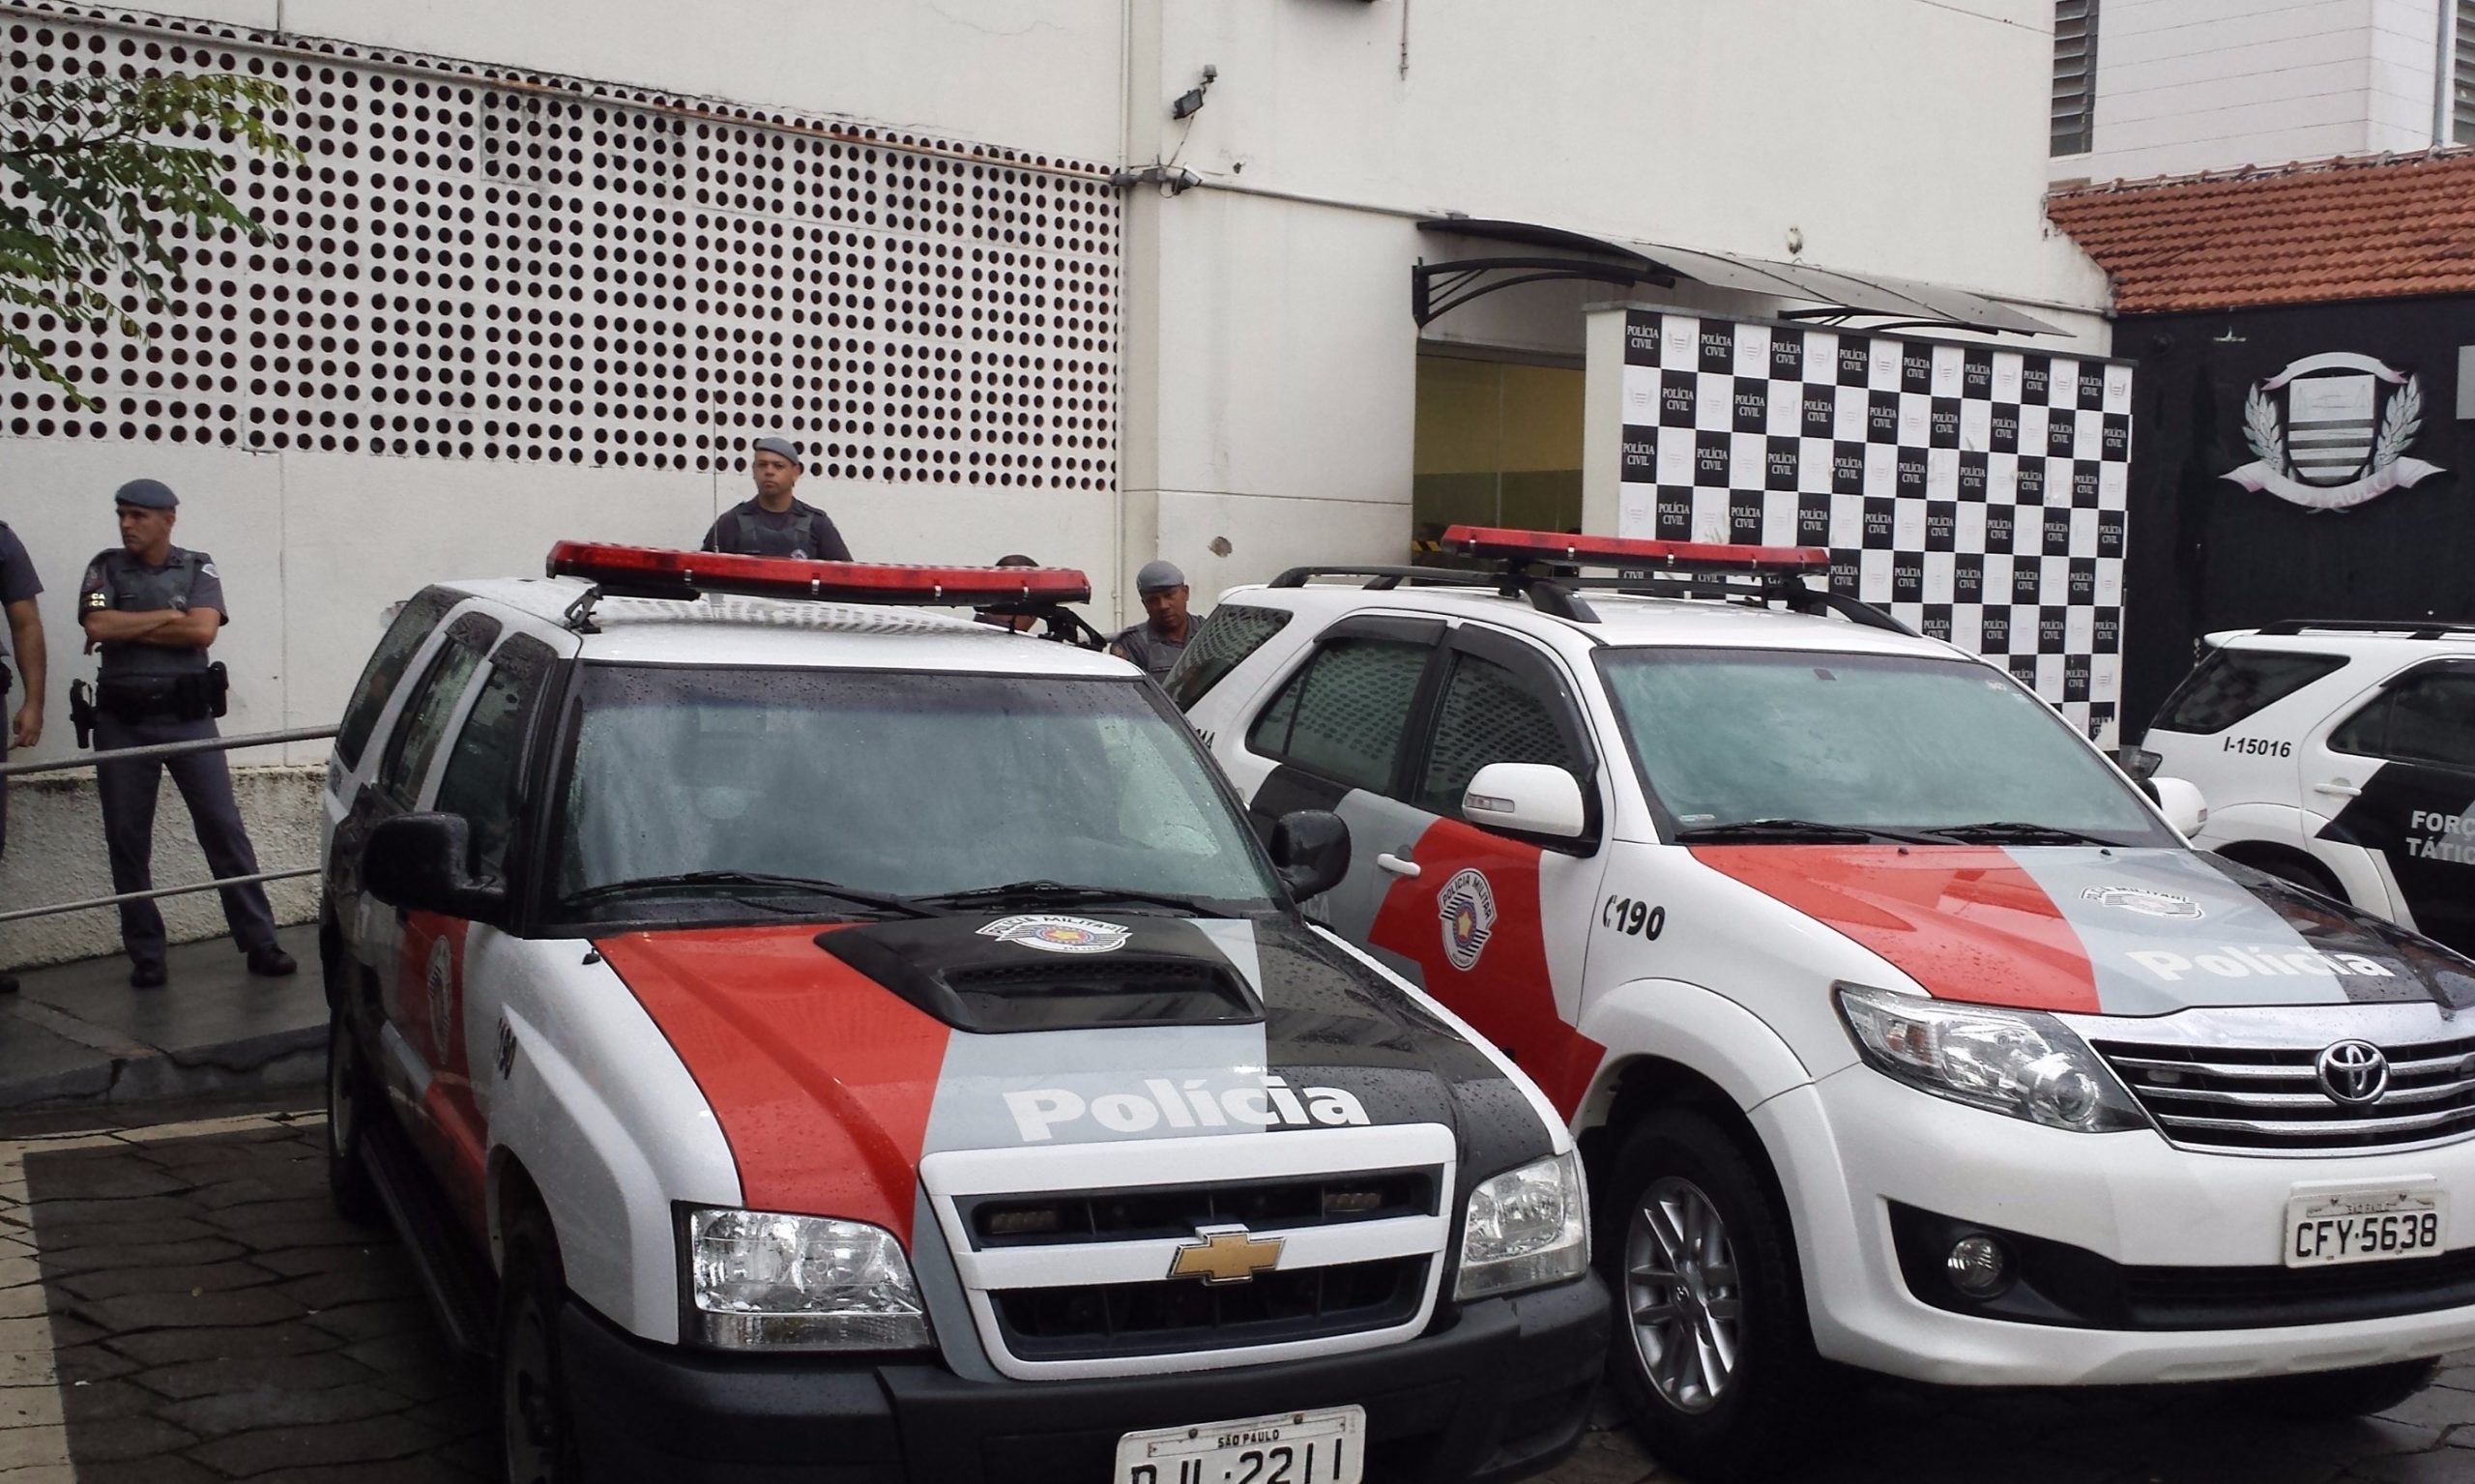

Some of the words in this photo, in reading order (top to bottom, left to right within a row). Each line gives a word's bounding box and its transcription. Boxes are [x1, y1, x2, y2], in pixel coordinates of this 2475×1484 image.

[1627, 325, 1659, 339] POLÍCIA
[1631, 337, 1653, 350] CIVIL
[1701, 333, 1732, 347] POLÍCIA
[1704, 346, 1727, 358] CIVIL
[1772, 341, 1801, 354] POLÍCIA
[1776, 354, 1796, 364] CIVIL
[1839, 349, 1867, 362] POLÍCIA
[1843, 361, 1863, 371] CIVIL
[1904, 357, 1931, 369] POLÍCIA
[1907, 368, 1926, 379] CIVIL
[1965, 364, 1991, 375] POLÍCIA
[1967, 374, 1986, 385] CIVIL
[1662, 387, 1694, 400] POLÍCIA
[1667, 399, 1689, 411] CIVIL
[1734, 393, 1765, 407] POLÍCIA
[1804, 399, 1832, 412] POLÍCIA
[1738, 406, 1760, 418] CIVIL
[1807, 412, 1827, 422] CIVIL
[1870, 406, 1897, 419] POLÍCIA
[1933, 412, 1959, 423] POLÍCIA
[1873, 418, 1892, 428] CIVIL
[1936, 423, 1954, 433] CIVIL
[1992, 418, 2017, 429] POLÍCIA
[1995, 428, 2013, 439] CIVIL
[1623, 441, 1655, 455] POLÍCIA
[1697, 447, 1728, 460] POLÍCIA
[1626, 454, 1649, 466] CIVIL
[1767, 452, 1797, 464] POLÍCIA
[1835, 456, 1863, 469] POLÍCIA
[1701, 459, 1723, 471] CIVIL
[1771, 464, 1792, 476] CIVIL
[1898, 462, 1926, 474] POLÍCIA
[1838, 468, 1858, 480] CIVIL
[1960, 466, 1986, 478] POLÍCIA
[1902, 474, 1921, 483] CIVIL
[1963, 478, 1981, 487] CIVIL
[1658, 502, 1690, 514] POLÍCIA
[1731, 505, 1761, 517] POLÍCIA
[1799, 508, 1828, 520] POLÍCIA
[1663, 514, 1684, 525] CIVIL
[1734, 518, 1756, 529] CIVIL
[1865, 511, 1892, 524] POLÍCIA
[1927, 515, 1954, 527] POLÍCIA
[1987, 517, 2012, 530] POLÍCIA
[1803, 520, 1823, 531] CIVIL
[1868, 524, 1887, 534] CIVIL
[1931, 527, 1949, 537] CIVIL
[1991, 530, 2008, 539] CIVIL
[1830, 563, 1858, 575] POLÍCIA
[1895, 566, 1921, 577] POLÍCIA
[1956, 567, 1981, 579] POLÍCIA
[1834, 576, 1853, 586] CIVIL
[1898, 578, 1917, 588] CIVIL
[1959, 579, 1977, 589] CIVIL
[1923, 618, 1950, 629] POLÍCIA
[1983, 618, 2008, 630] POLÍCIA
[1986, 630, 2004, 640] CIVIL
[2223, 736, 2292, 758] I-15016
[1442, 874, 1470, 906] POLICIA
[1471, 876, 1492, 919] MILITAR
[1616, 898, 1666, 941] 190
[2126, 946, 2396, 981] Polícia
[1003, 1075, 1371, 1143] Polícia
[1242, 1429, 1280, 1446] PAULO
